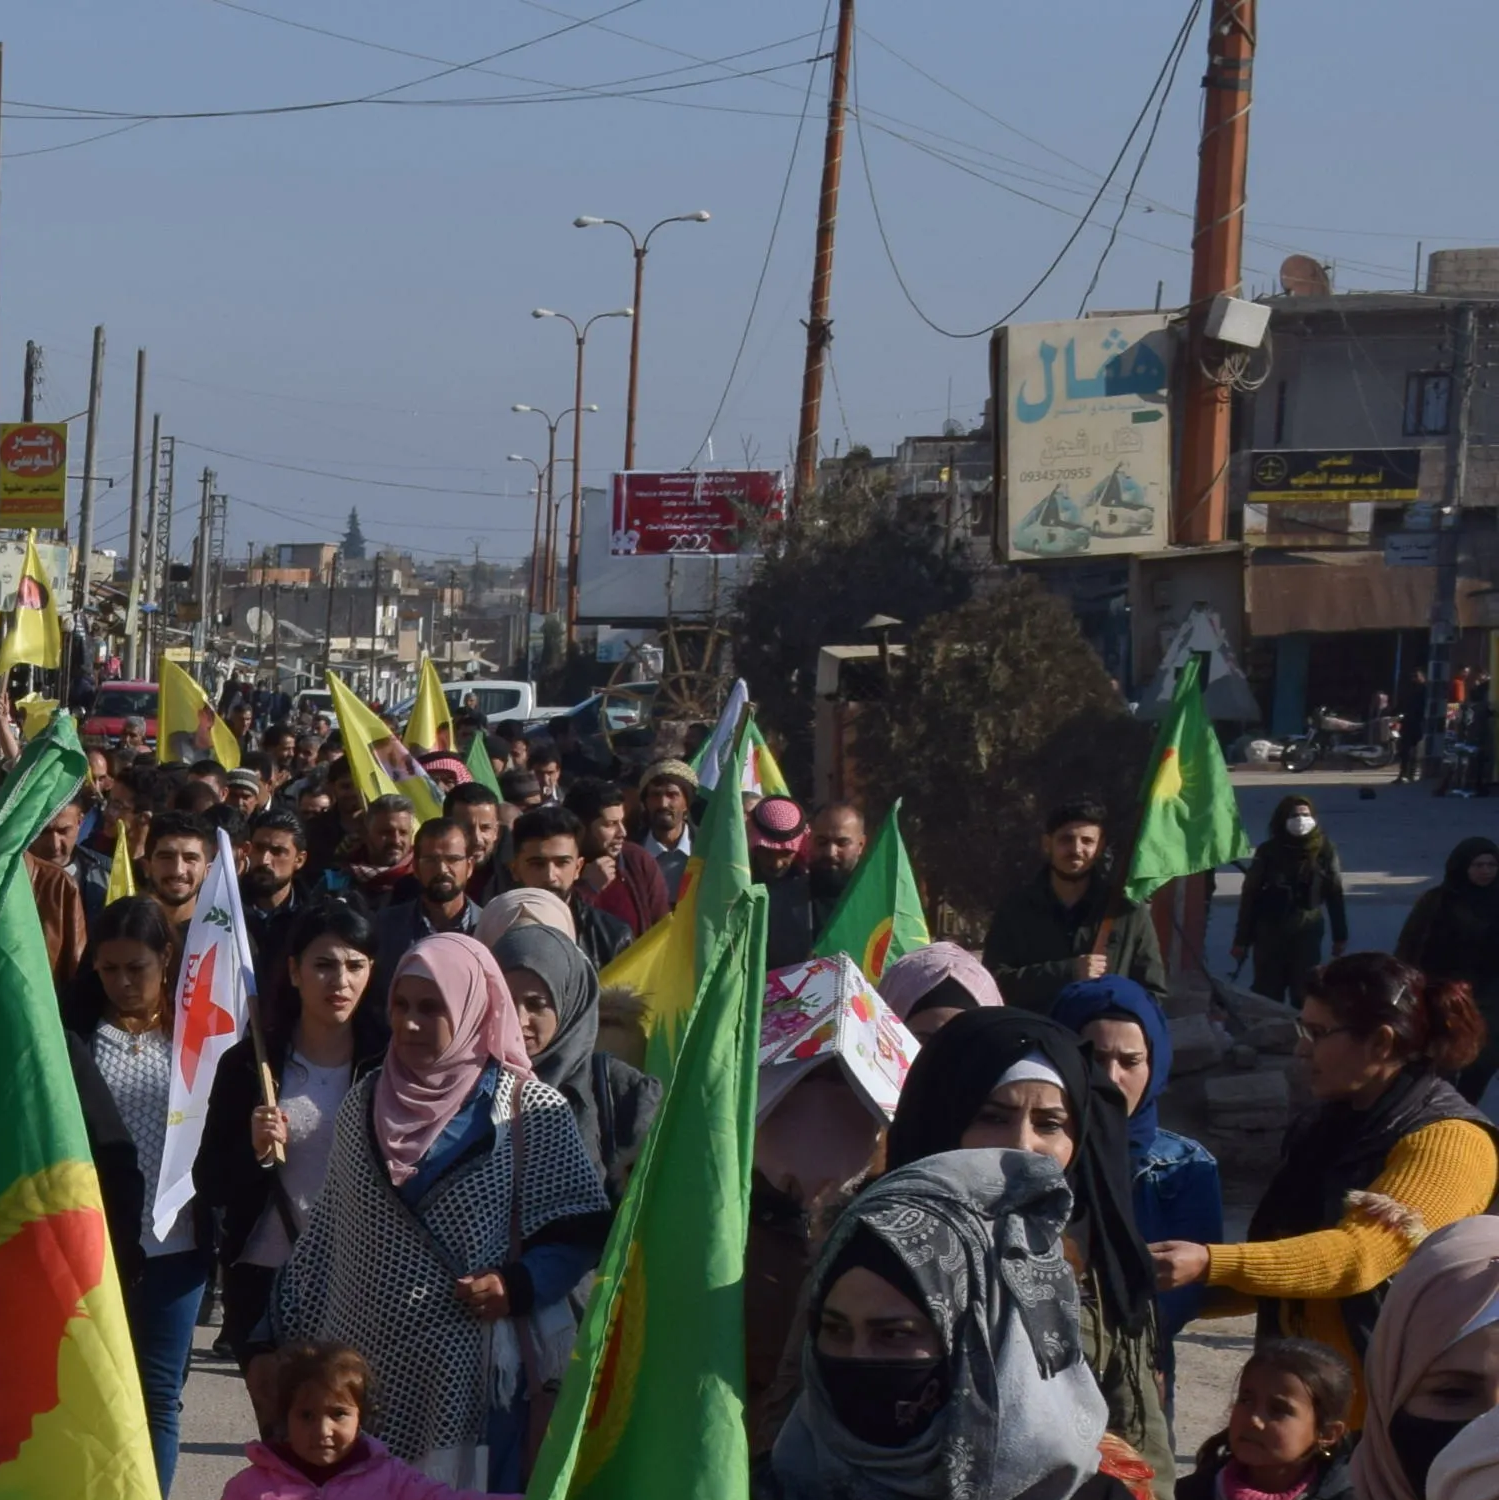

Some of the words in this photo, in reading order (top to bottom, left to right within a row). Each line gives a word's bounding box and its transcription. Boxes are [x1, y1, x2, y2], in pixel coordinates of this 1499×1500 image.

[11, 430, 54, 453] مخبر
[1020, 467, 1092, 483] 0934570955
[667, 533, 712, 552] 2022
